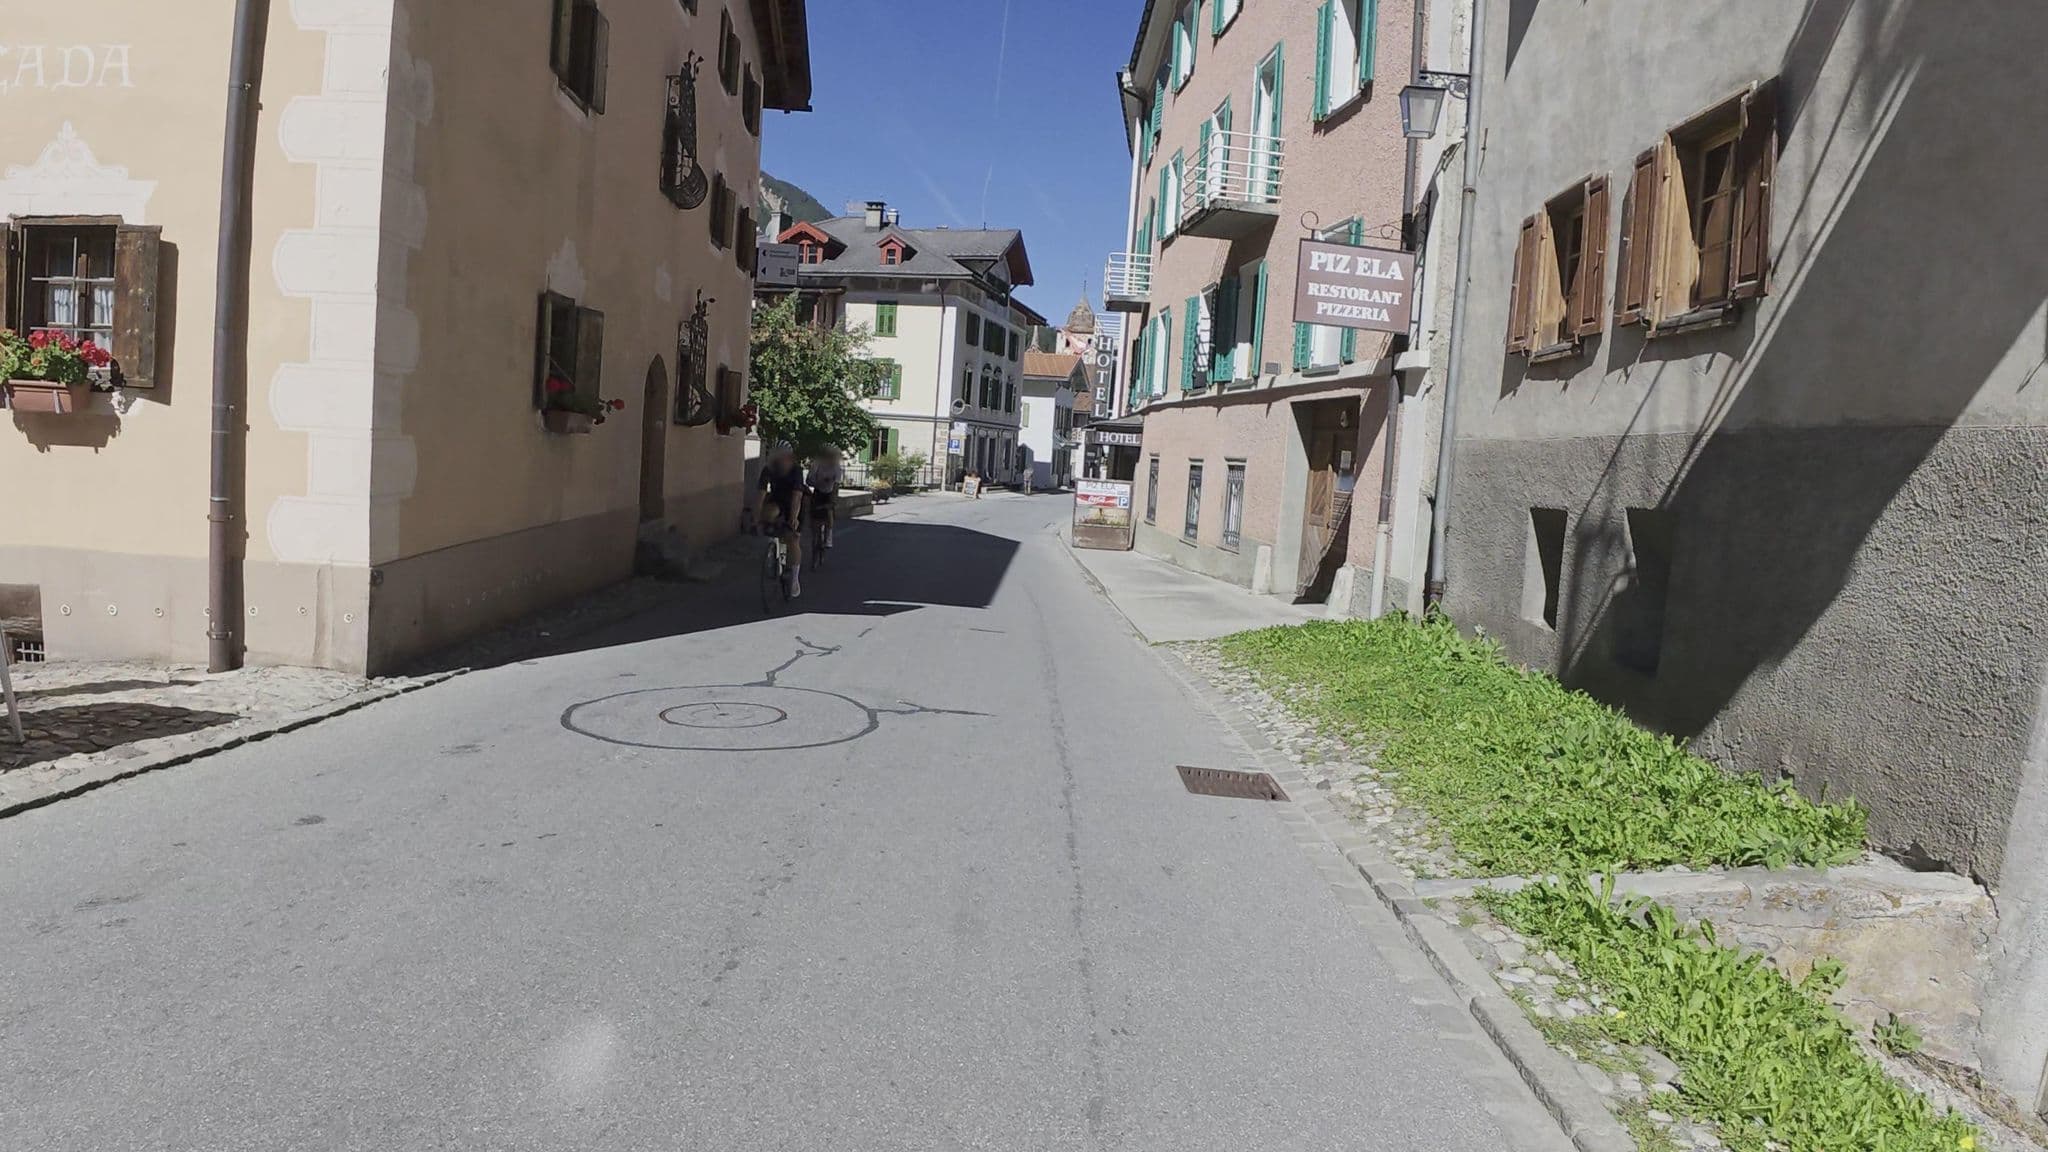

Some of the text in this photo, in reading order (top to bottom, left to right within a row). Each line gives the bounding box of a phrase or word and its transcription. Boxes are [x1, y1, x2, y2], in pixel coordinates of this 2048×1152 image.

[1310, 251, 1404, 280] PIZ ELA
[1308, 283, 1402, 305] RESTORANT
[1317, 302, 1390, 321] PIZZERIA
[1095, 336, 1112, 417] HOTEL
[1099, 431, 1140, 444] HOTEL
